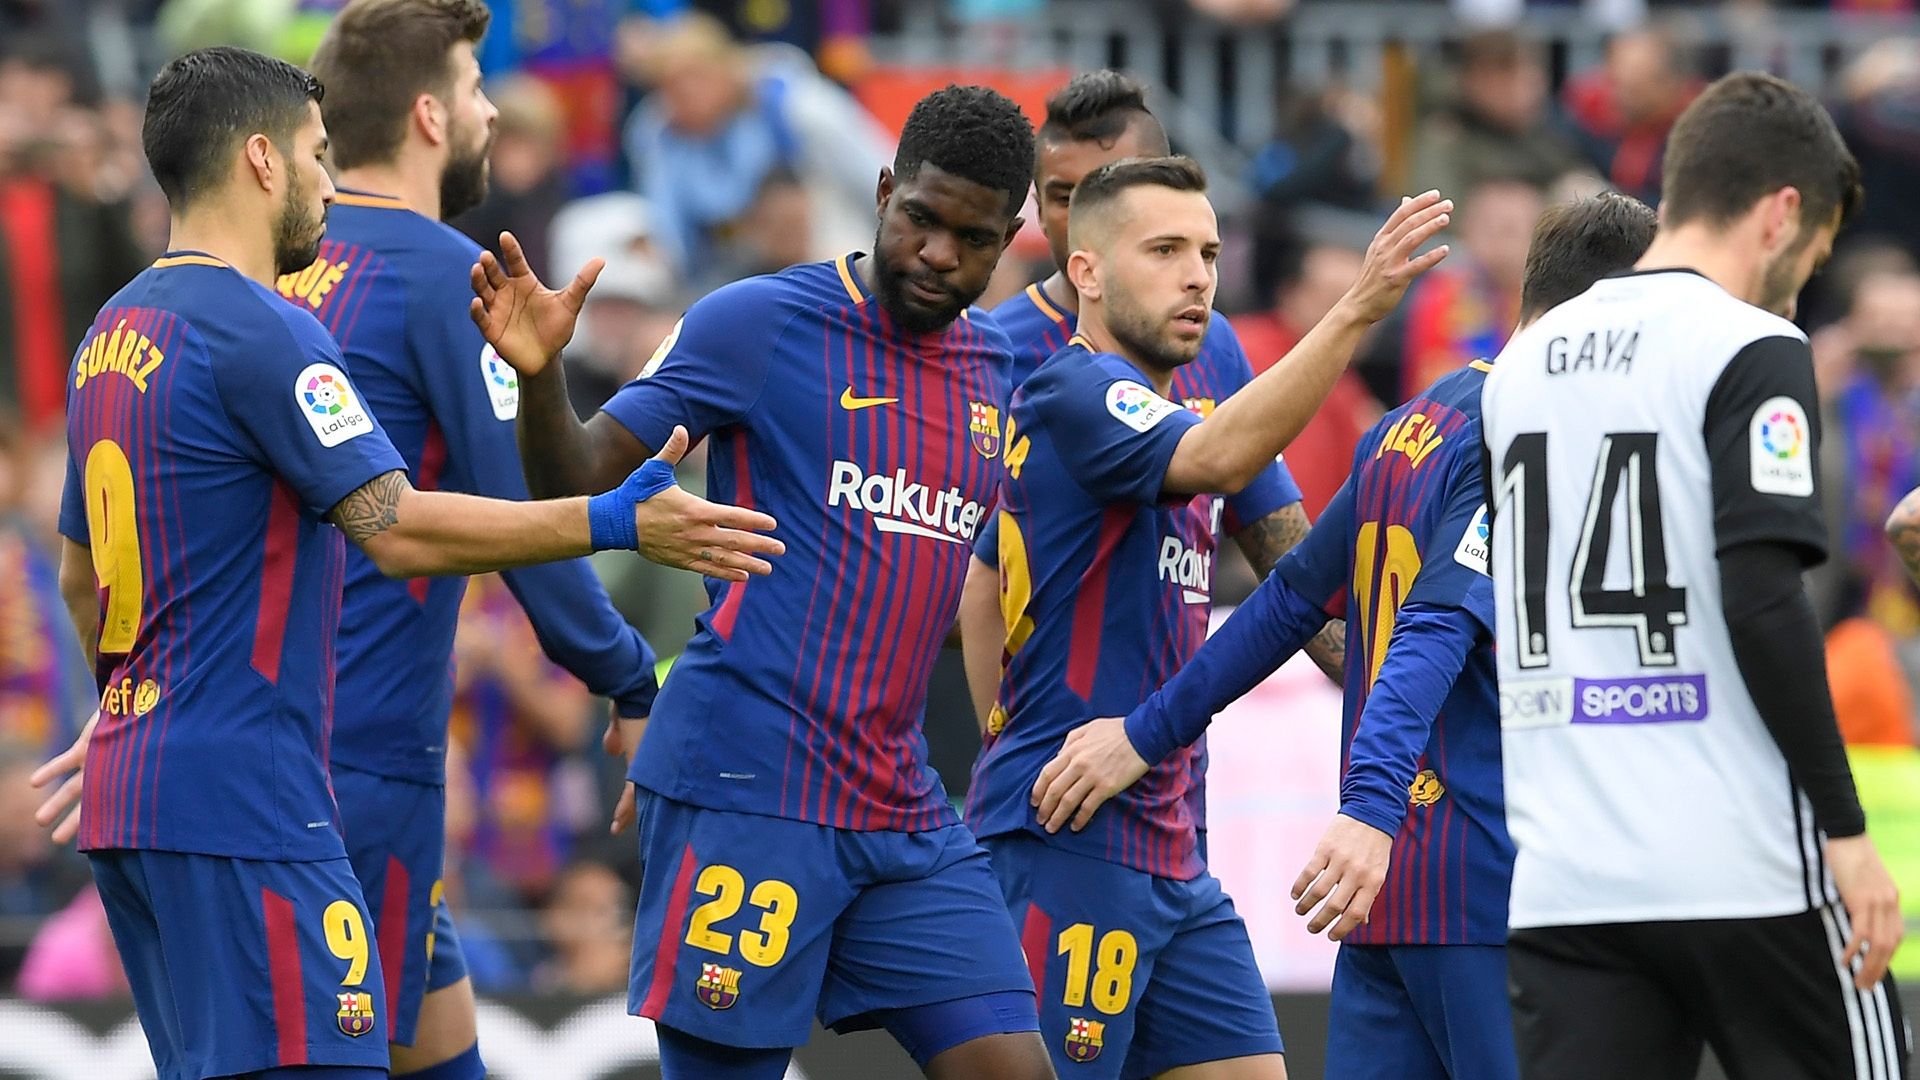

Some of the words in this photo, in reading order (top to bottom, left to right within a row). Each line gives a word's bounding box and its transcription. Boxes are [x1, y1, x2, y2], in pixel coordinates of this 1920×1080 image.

[76, 318, 164, 393] SUÁREZ
[322, 414, 363, 436] LaLiga
[84, 439, 143, 653] 9
[1494, 432, 1687, 668] 14
[1582, 682, 1699, 717] SPORTS
[323, 900, 369, 985] 9
[685, 864, 799, 968] 23
[1058, 923, 1137, 1015] 18
